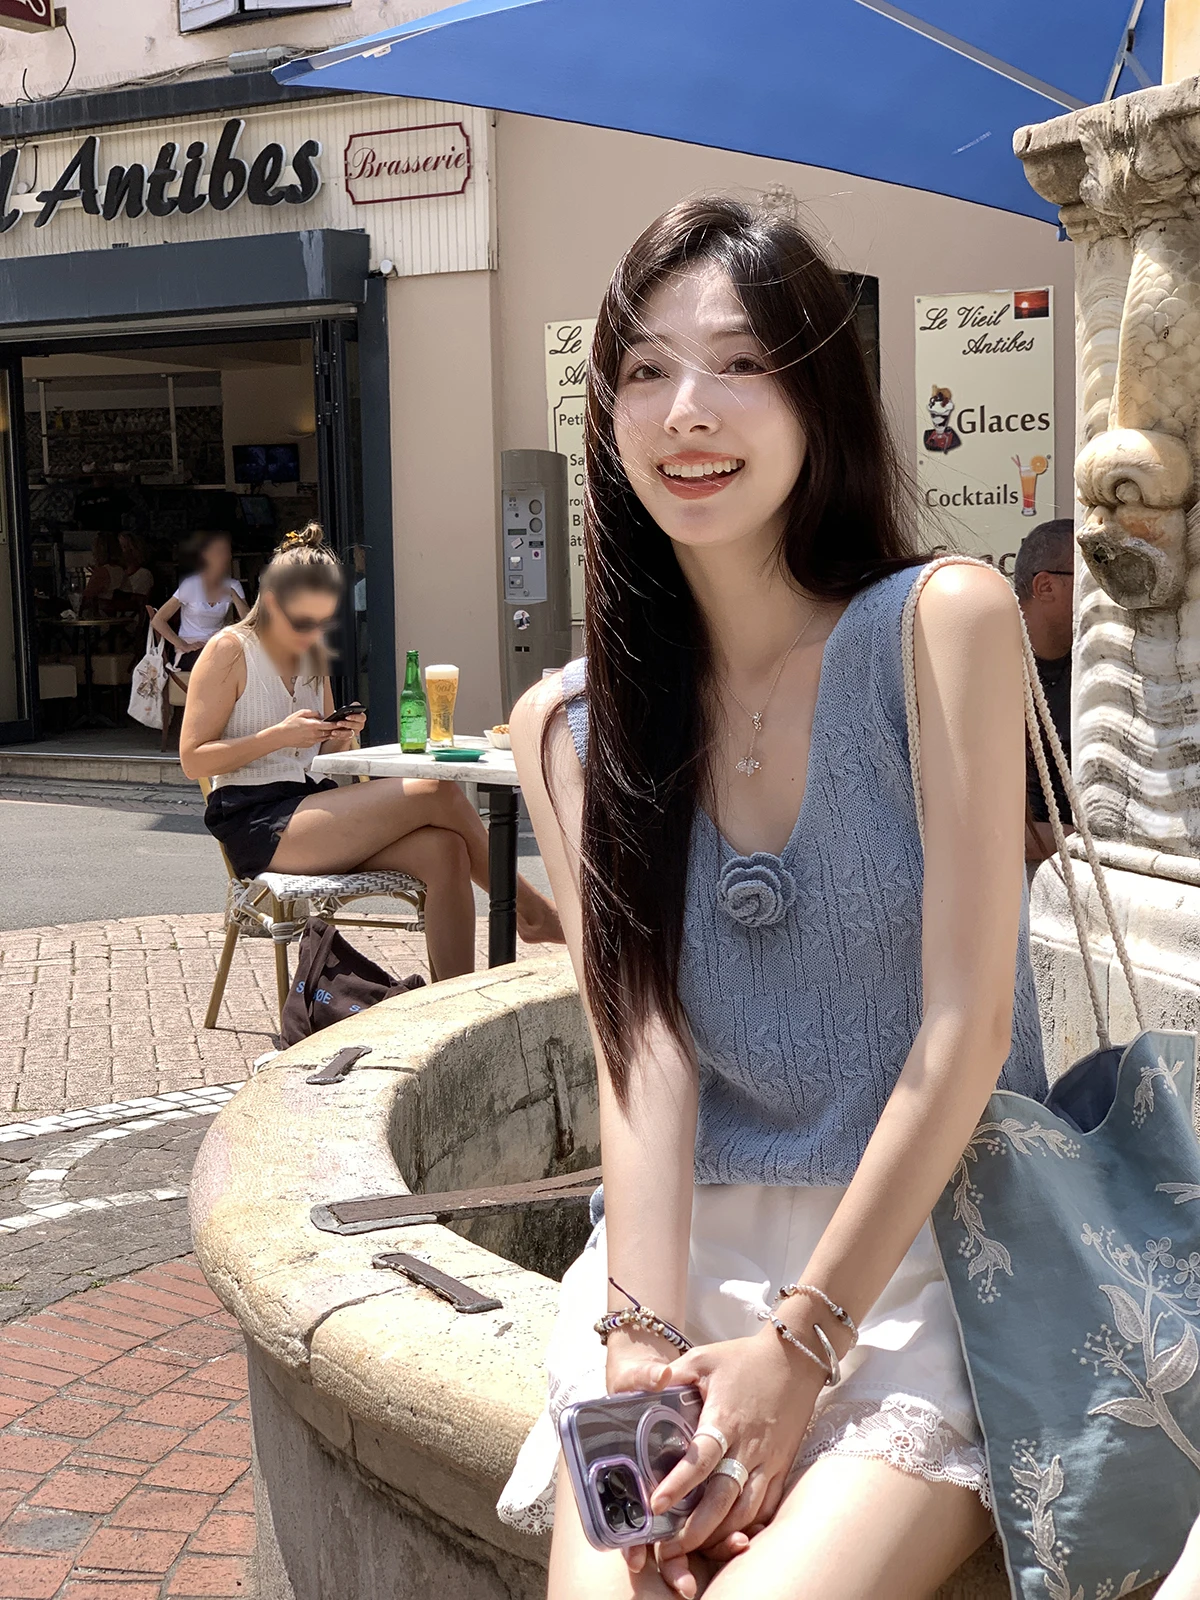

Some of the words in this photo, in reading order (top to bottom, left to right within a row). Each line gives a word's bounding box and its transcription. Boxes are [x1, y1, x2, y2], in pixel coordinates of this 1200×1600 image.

[34, 118, 320, 228] Antibes
[348, 146, 465, 180] Brasserie
[919, 308, 948, 331] Le
[957, 304, 1011, 329] Vieil
[549, 326, 582, 355] Le
[962, 331, 1035, 356] Antibes
[559, 412, 585, 426] Peti
[956, 405, 1051, 434] Glaces
[925, 484, 1019, 508] Cocktails
